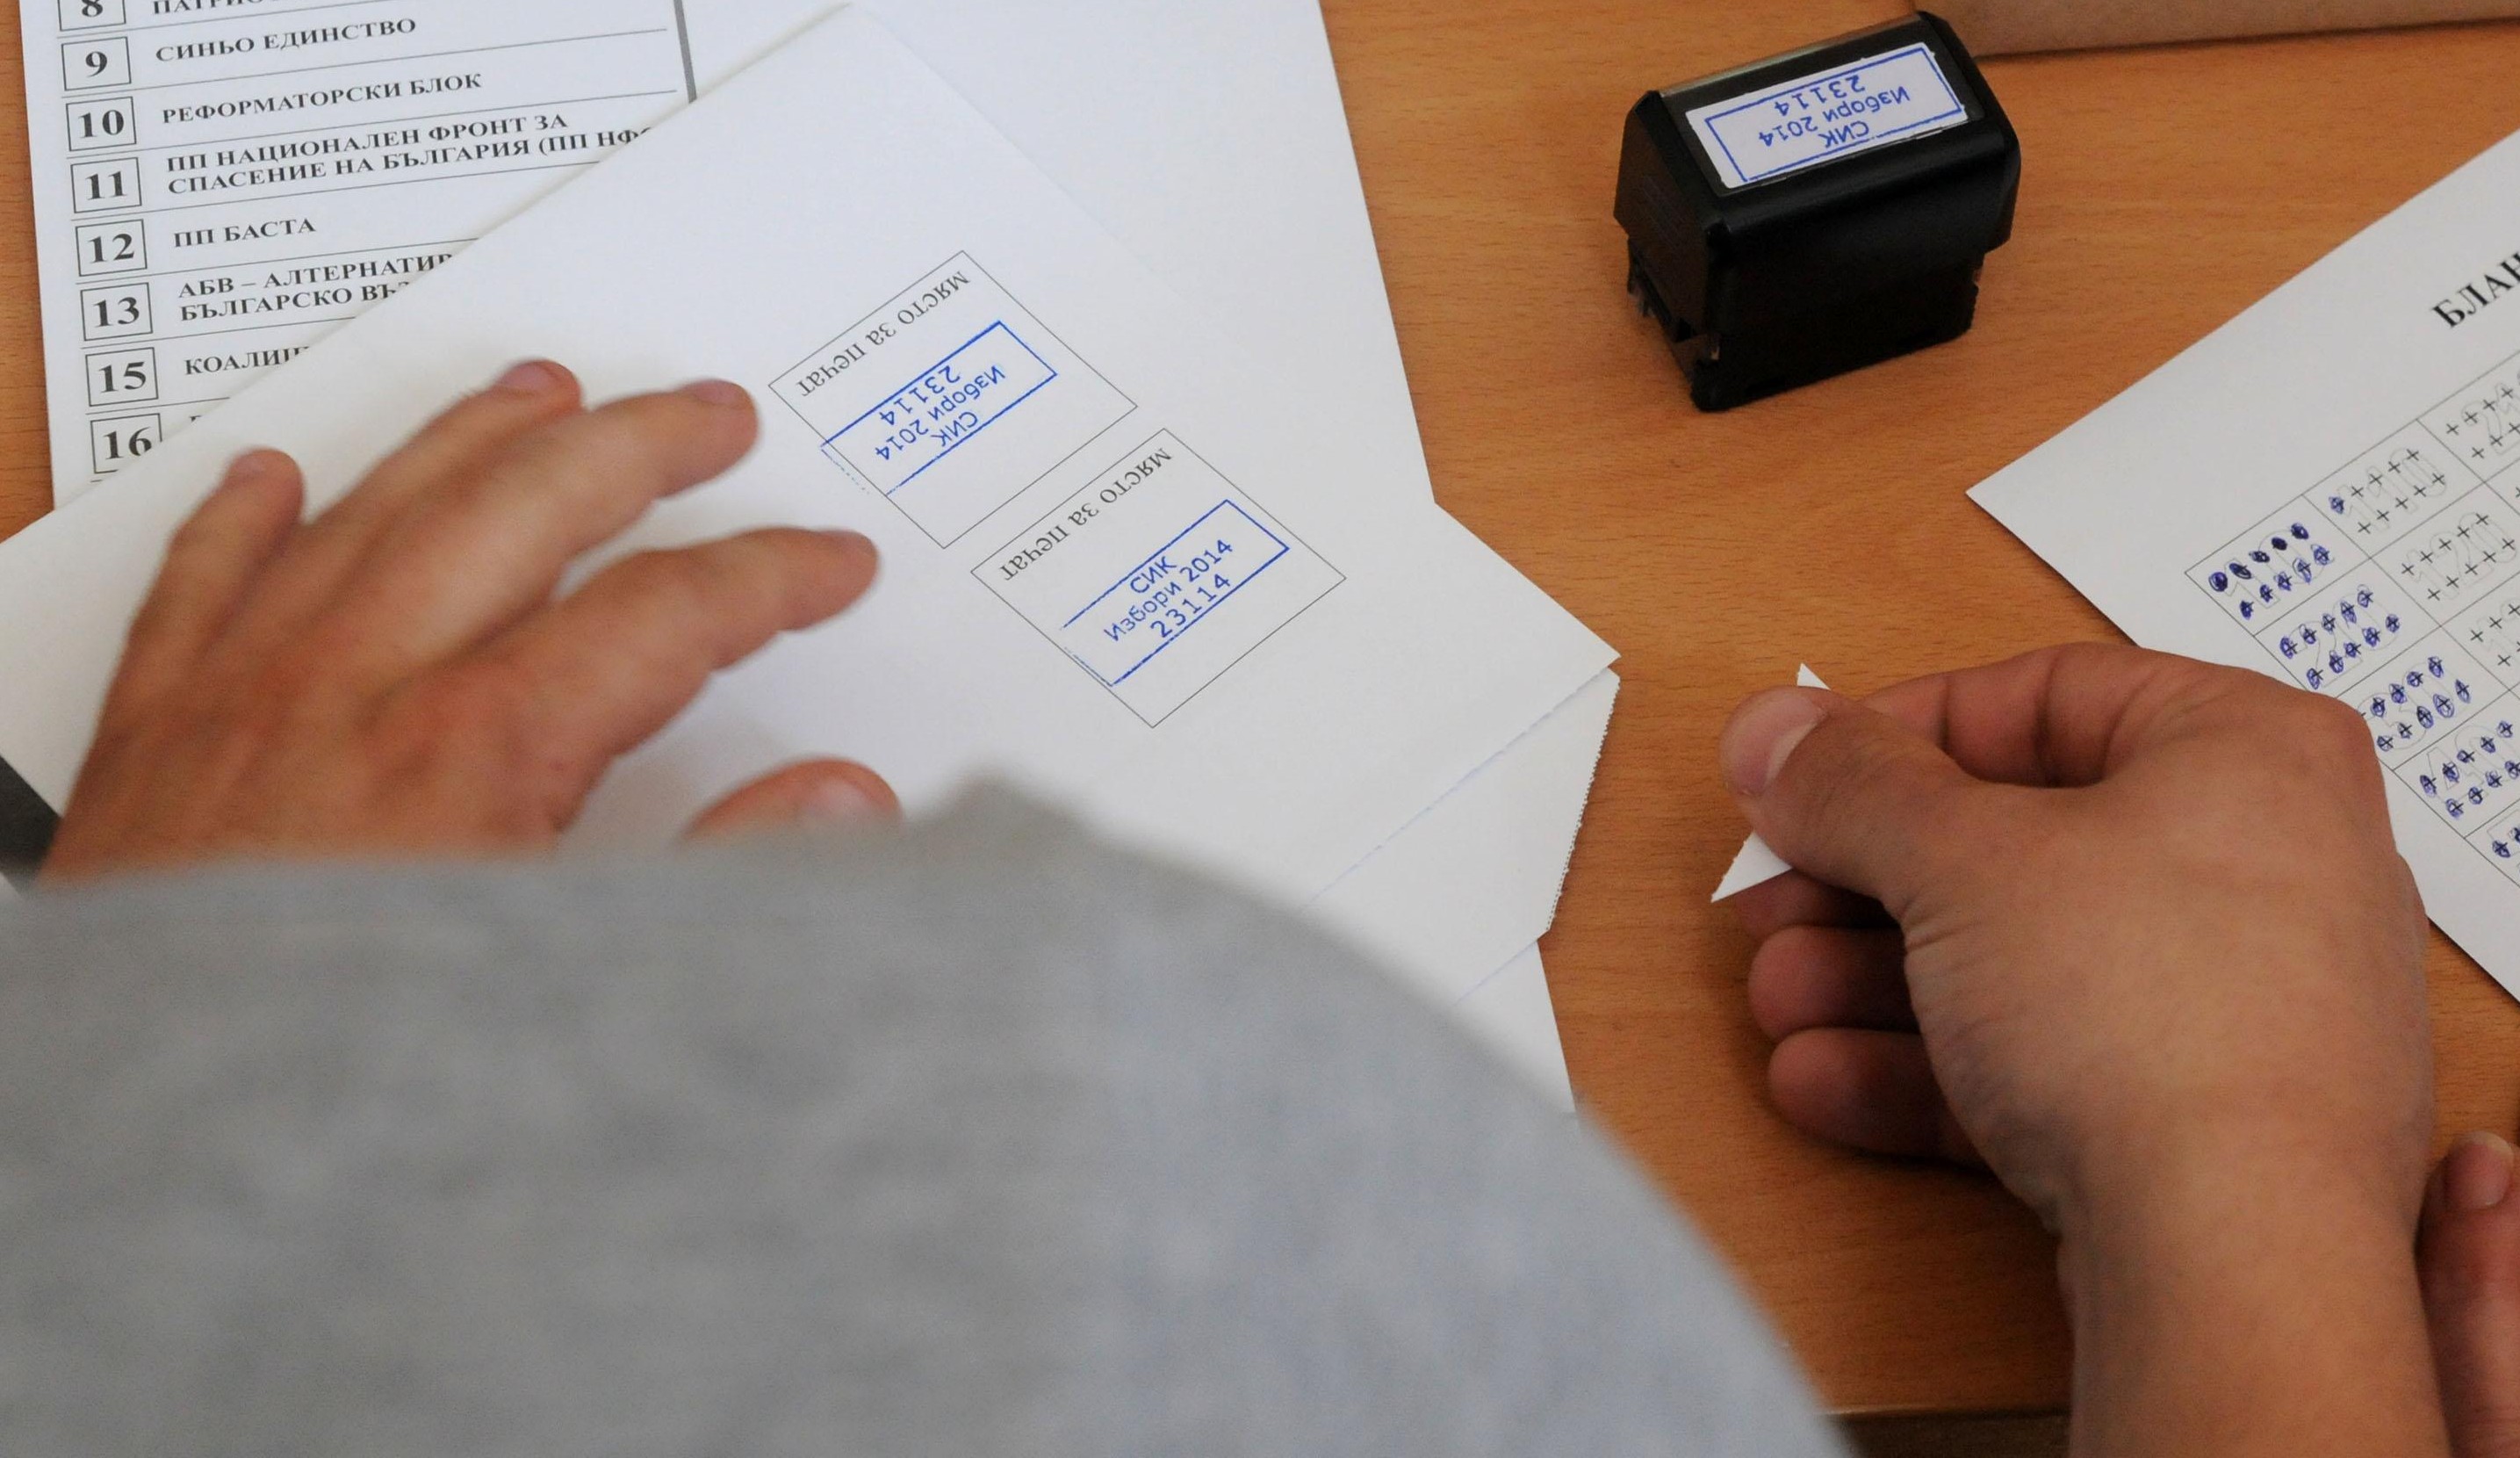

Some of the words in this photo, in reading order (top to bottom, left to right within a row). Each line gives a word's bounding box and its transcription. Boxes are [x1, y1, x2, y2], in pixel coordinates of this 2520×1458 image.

[82, 0, 103, 17] 8
[155, 37, 256, 62] СИНЬО
[263, 18, 416, 50] ЕДИНСТВО
[85, 51, 107, 77] 9
[162, 81, 401, 124] РЕФОРМАТОРСКИ
[410, 73, 482, 96] БЛОК
[1775, 75, 1865, 116] 23114
[1823, 86, 1911, 122] Избори
[78, 109, 124, 139] 10
[1759, 116, 1818, 147] 2014
[1818, 120, 1868, 148] СИК
[166, 154, 207, 172] ПП
[217, 128, 421, 167] НАЦИОНАЛЕН
[428, 116, 527, 141] ФРОНТ
[534, 114, 568, 130] ЗА
[168, 162, 327, 195] СПАСЕНИЕ
[335, 157, 375, 175] НА
[383, 139, 530, 170] БЪЛГАРИЯ
[538, 134, 588, 155] (ПП
[597, 126, 652, 148] НФ
[86, 170, 127, 200] 11
[89, 233, 135, 263] 12
[175, 228, 213, 248] ПП
[225, 218, 316, 242] БАСТА
[178, 277, 234, 299] АБВ
[180, 288, 352, 322] БЪЛГАРСКО
[361, 281, 409, 301] ВЪ
[94, 297, 140, 327] 13
[866, 321, 896, 346] за
[99, 361, 147, 393] 15
[796, 343, 867, 397] печат
[879, 365, 961, 425] 23114
[927, 364, 1006, 421] Избори
[104, 426, 153, 460] 16
[875, 418, 929, 460] 2014
[931, 411, 978, 447] СИК
[1068, 501, 1099, 526] за
[1000, 523, 1069, 581] печат
[1103, 579, 1183, 642] Избори
[1181, 538, 1234, 581] 2014
[1129, 555, 1177, 595] СИК
[1150, 572, 1231, 639] 23114
